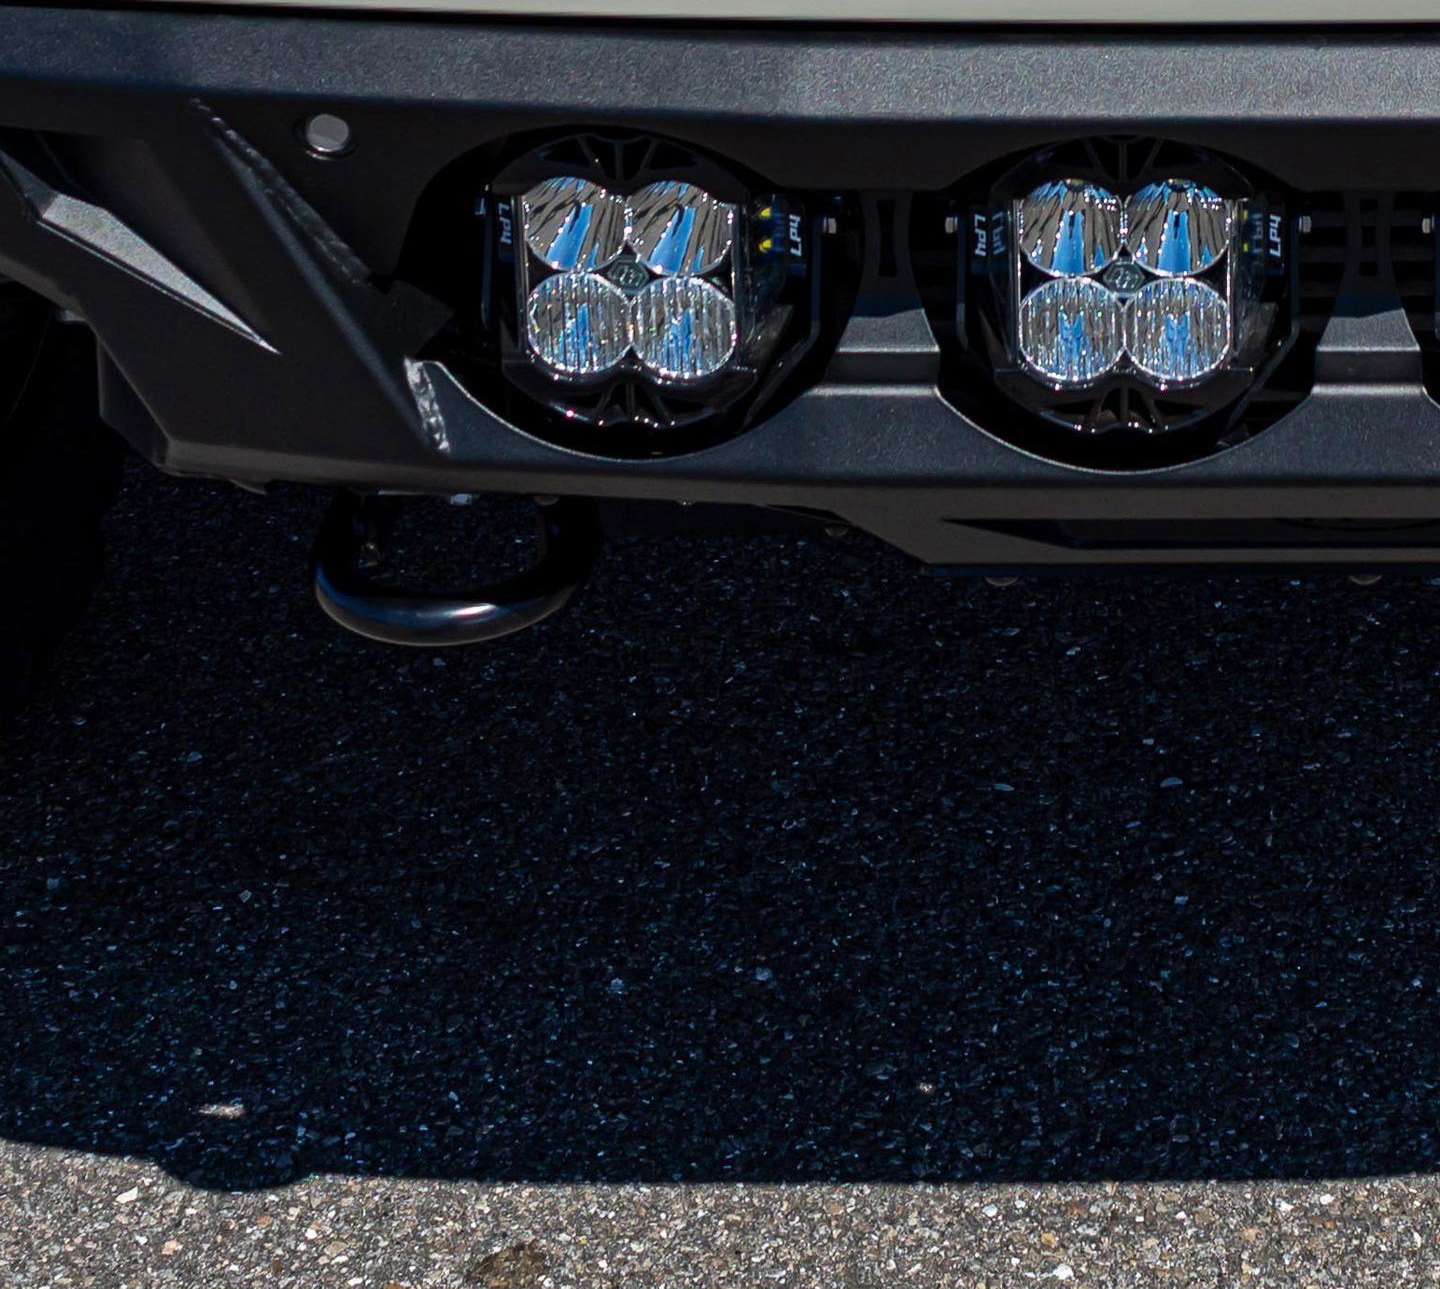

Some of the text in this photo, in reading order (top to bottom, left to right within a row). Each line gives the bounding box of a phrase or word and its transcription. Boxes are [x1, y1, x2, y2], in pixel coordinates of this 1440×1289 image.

[497, 203, 512, 244] LP4
[789, 214, 802, 257] LP4
[974, 213, 988, 257] LP4
[1269, 213, 1282, 258] LP4
